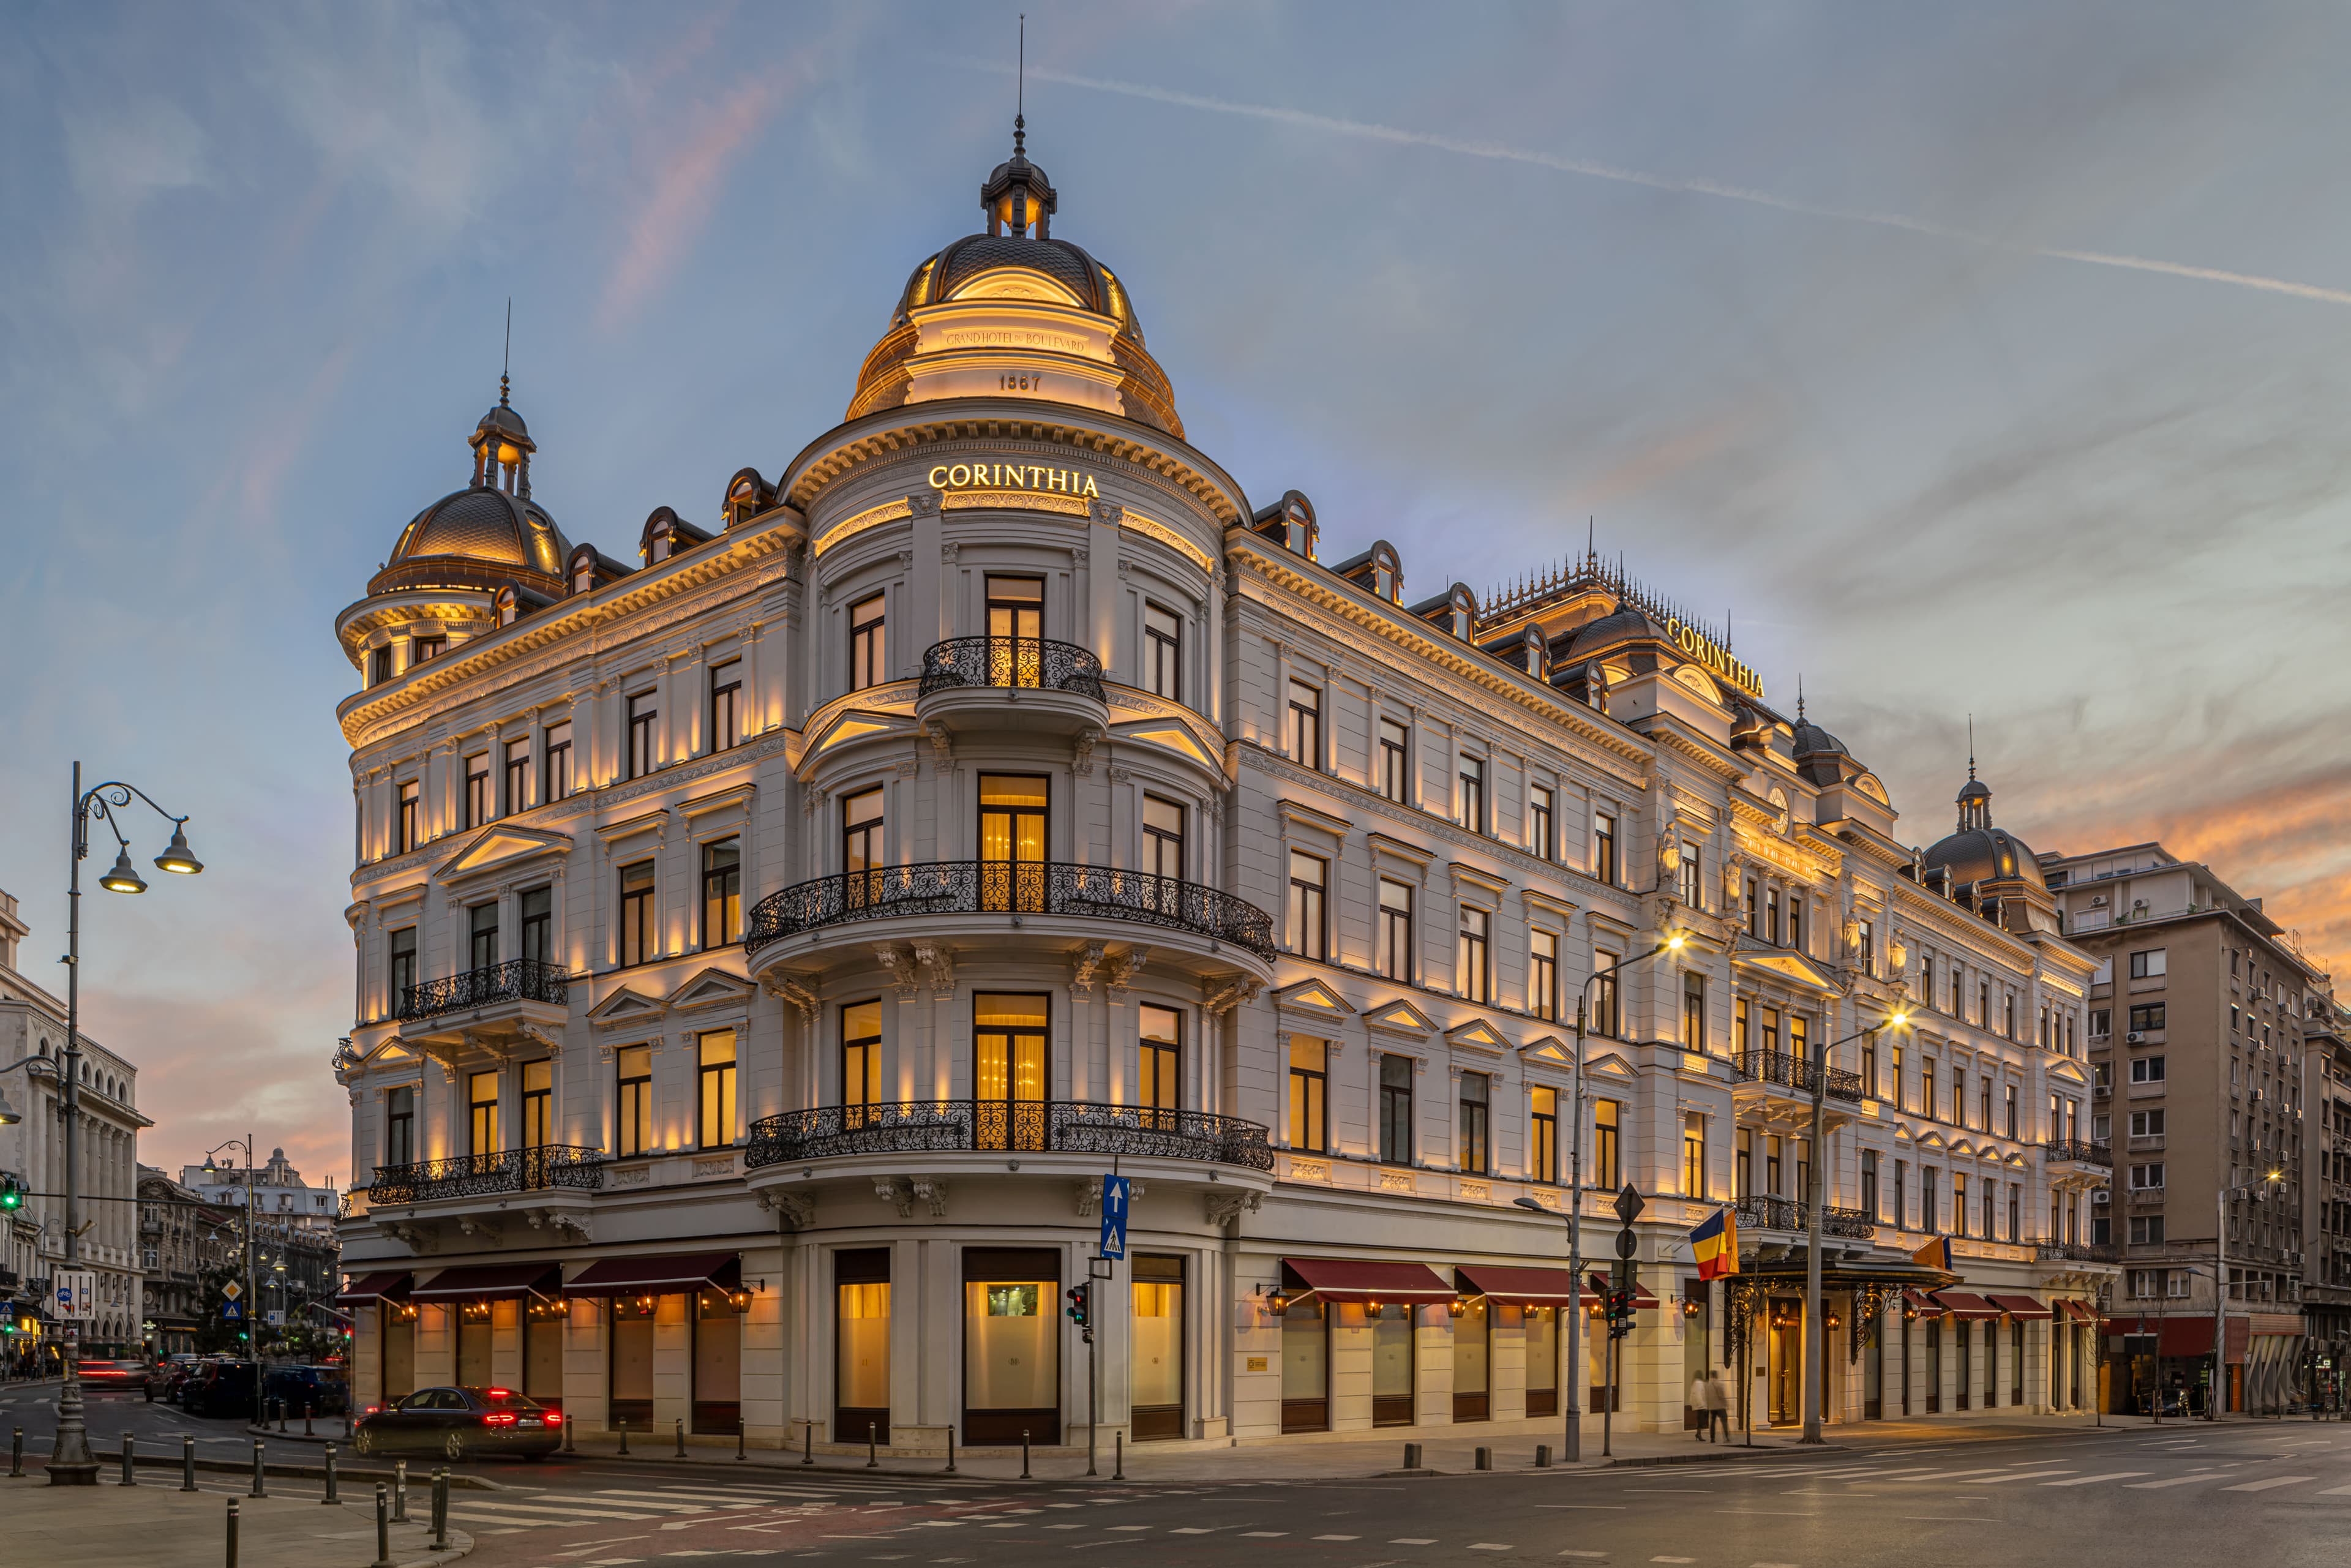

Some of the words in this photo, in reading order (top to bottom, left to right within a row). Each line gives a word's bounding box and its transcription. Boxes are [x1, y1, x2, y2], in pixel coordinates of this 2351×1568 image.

[947, 332, 980, 345] GRAND
[982, 332, 1014, 343] HOTEL
[1026, 333, 1084, 352] BOULEVARD
[999, 375, 1041, 392] 1867
[928, 463, 1100, 498] CORINTHIA
[1668, 618, 1765, 697] CORINTHIA
